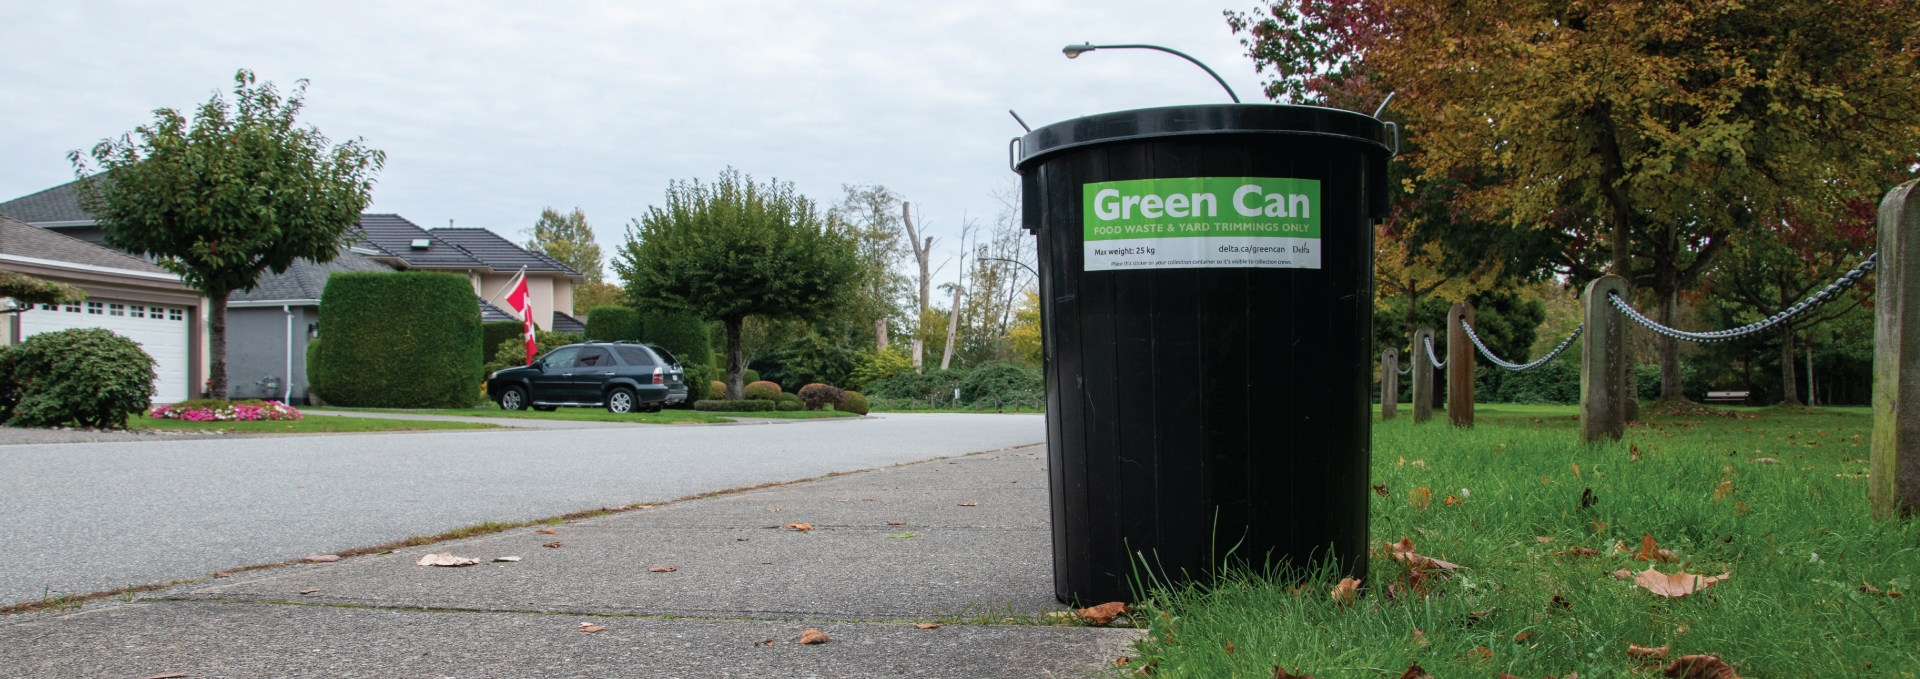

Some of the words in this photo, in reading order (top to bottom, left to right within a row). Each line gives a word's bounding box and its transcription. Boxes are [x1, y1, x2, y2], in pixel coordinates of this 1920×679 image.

[1093, 188, 1218, 221] Green
[1232, 184, 1310, 219] Can
[1094, 225, 1122, 235] FOOD
[1124, 224, 1164, 233] WASTE
[1167, 223, 1175, 232] &
[1178, 222, 1211, 232] YARD
[1214, 222, 1279, 232] TRIMMINGS
[1282, 223, 1310, 233] ONLY
[1108, 248, 1134, 256] weight:
[1146, 246, 1156, 256] kg
[1218, 244, 1286, 254] delta.ca/greencan
[1292, 242, 1310, 254] Delta
